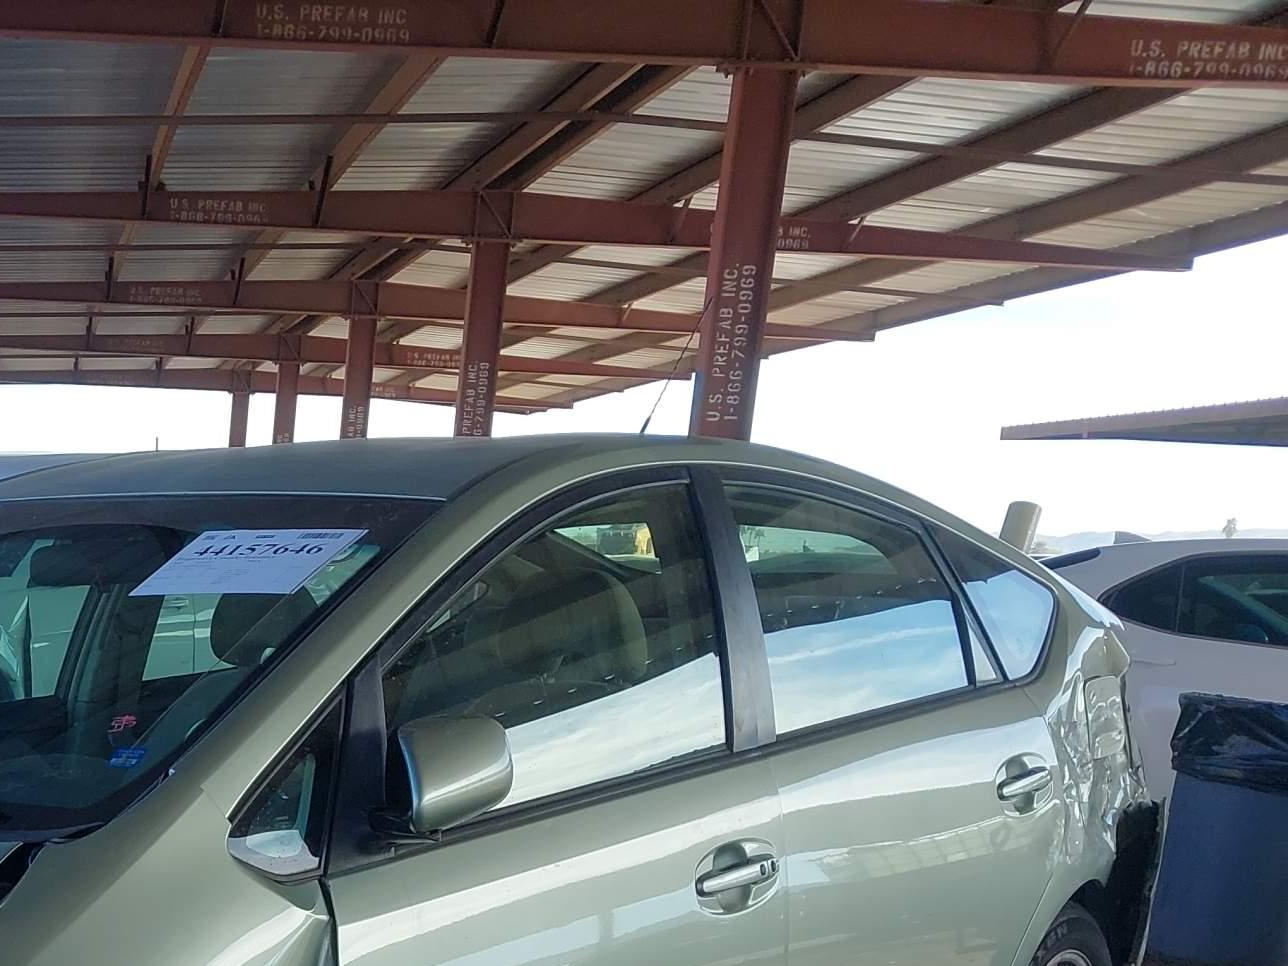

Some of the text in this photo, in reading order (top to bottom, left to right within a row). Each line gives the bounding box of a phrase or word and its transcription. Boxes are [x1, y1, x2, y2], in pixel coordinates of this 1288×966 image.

[256, 3, 289, 20] U.S.
[299, 4, 368, 22] PREFAB
[1130, 39, 1166, 58] U.S.
[1176, 41, 1250, 59] PREFAB
[198, 200, 243, 212] PREFAB
[706, 263, 740, 421] U.S. PREFAB INC.
[724, 264, 757, 420] 1-866-799-0969
[462, 389, 475, 433] PREFAB
[194, 543, 325, 556] 44157646
